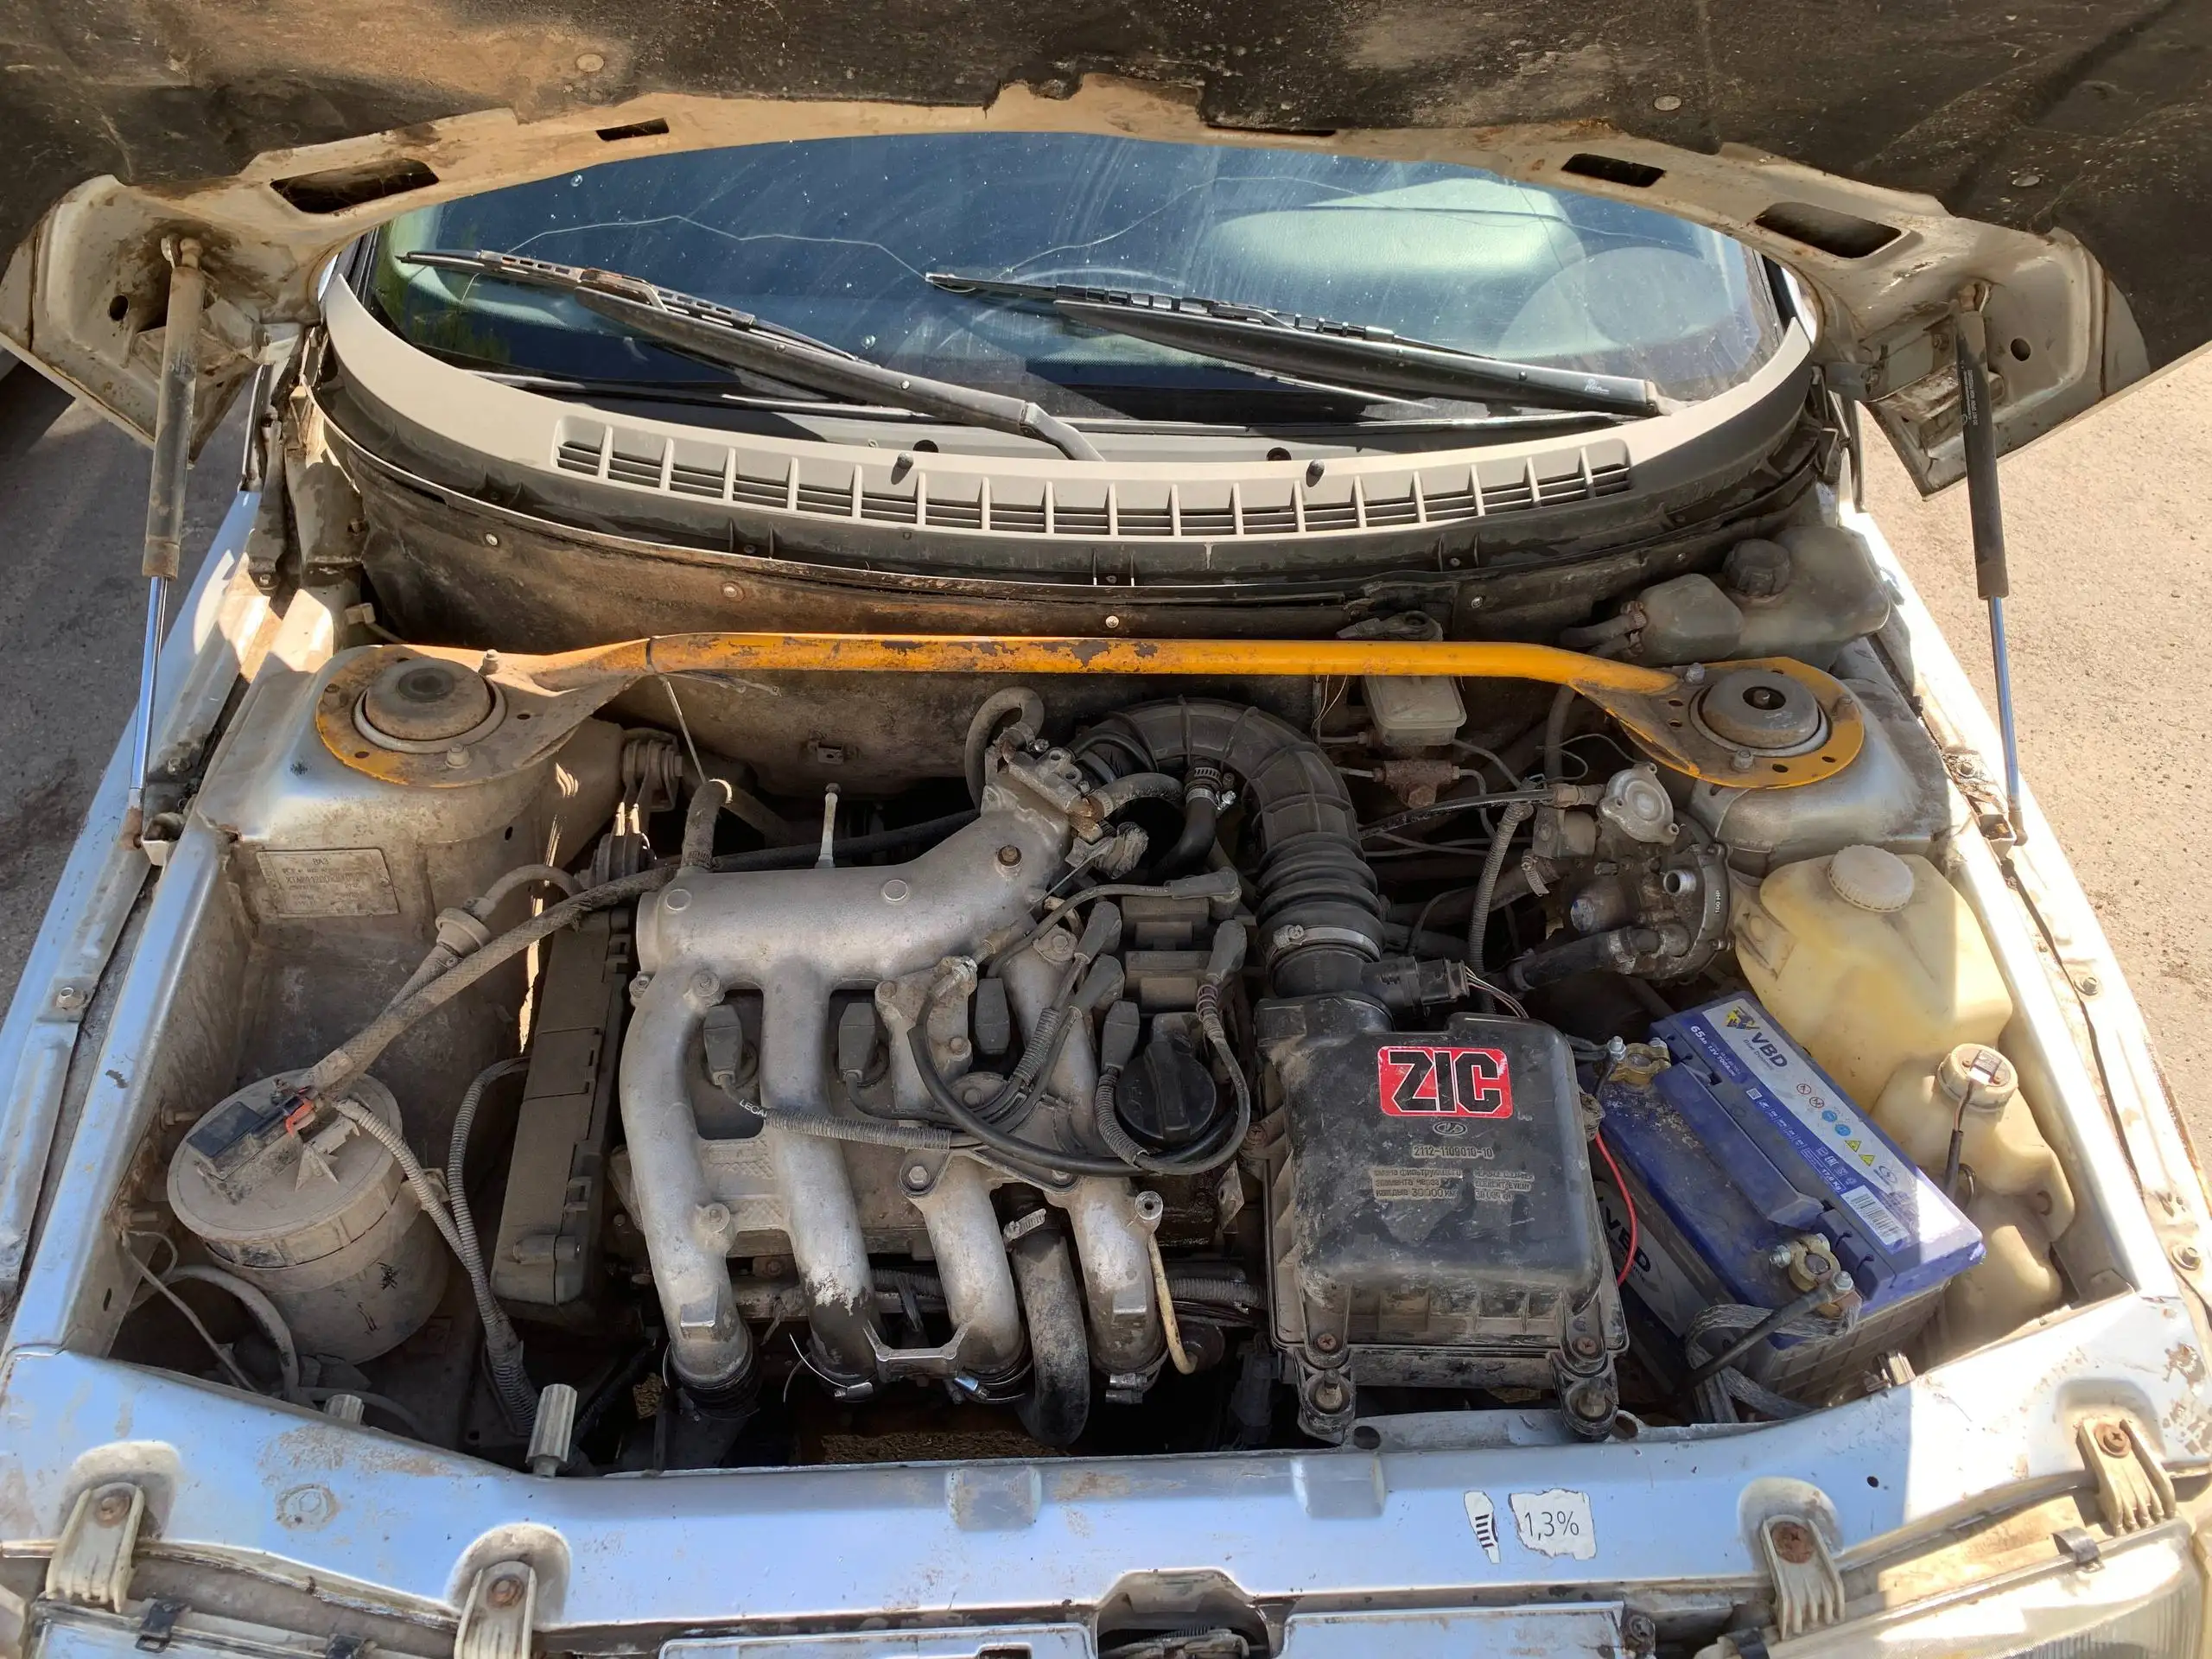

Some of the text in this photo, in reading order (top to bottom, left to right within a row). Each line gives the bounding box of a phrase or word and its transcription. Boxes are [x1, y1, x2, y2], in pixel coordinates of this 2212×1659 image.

[1751, 1032, 1788, 1068] VBD
[1387, 1051, 1503, 1114] ZIC
[1414, 1147, 1493, 1158] 2112-1109010-10
[1525, 1511, 1580, 1541] 1,3%
